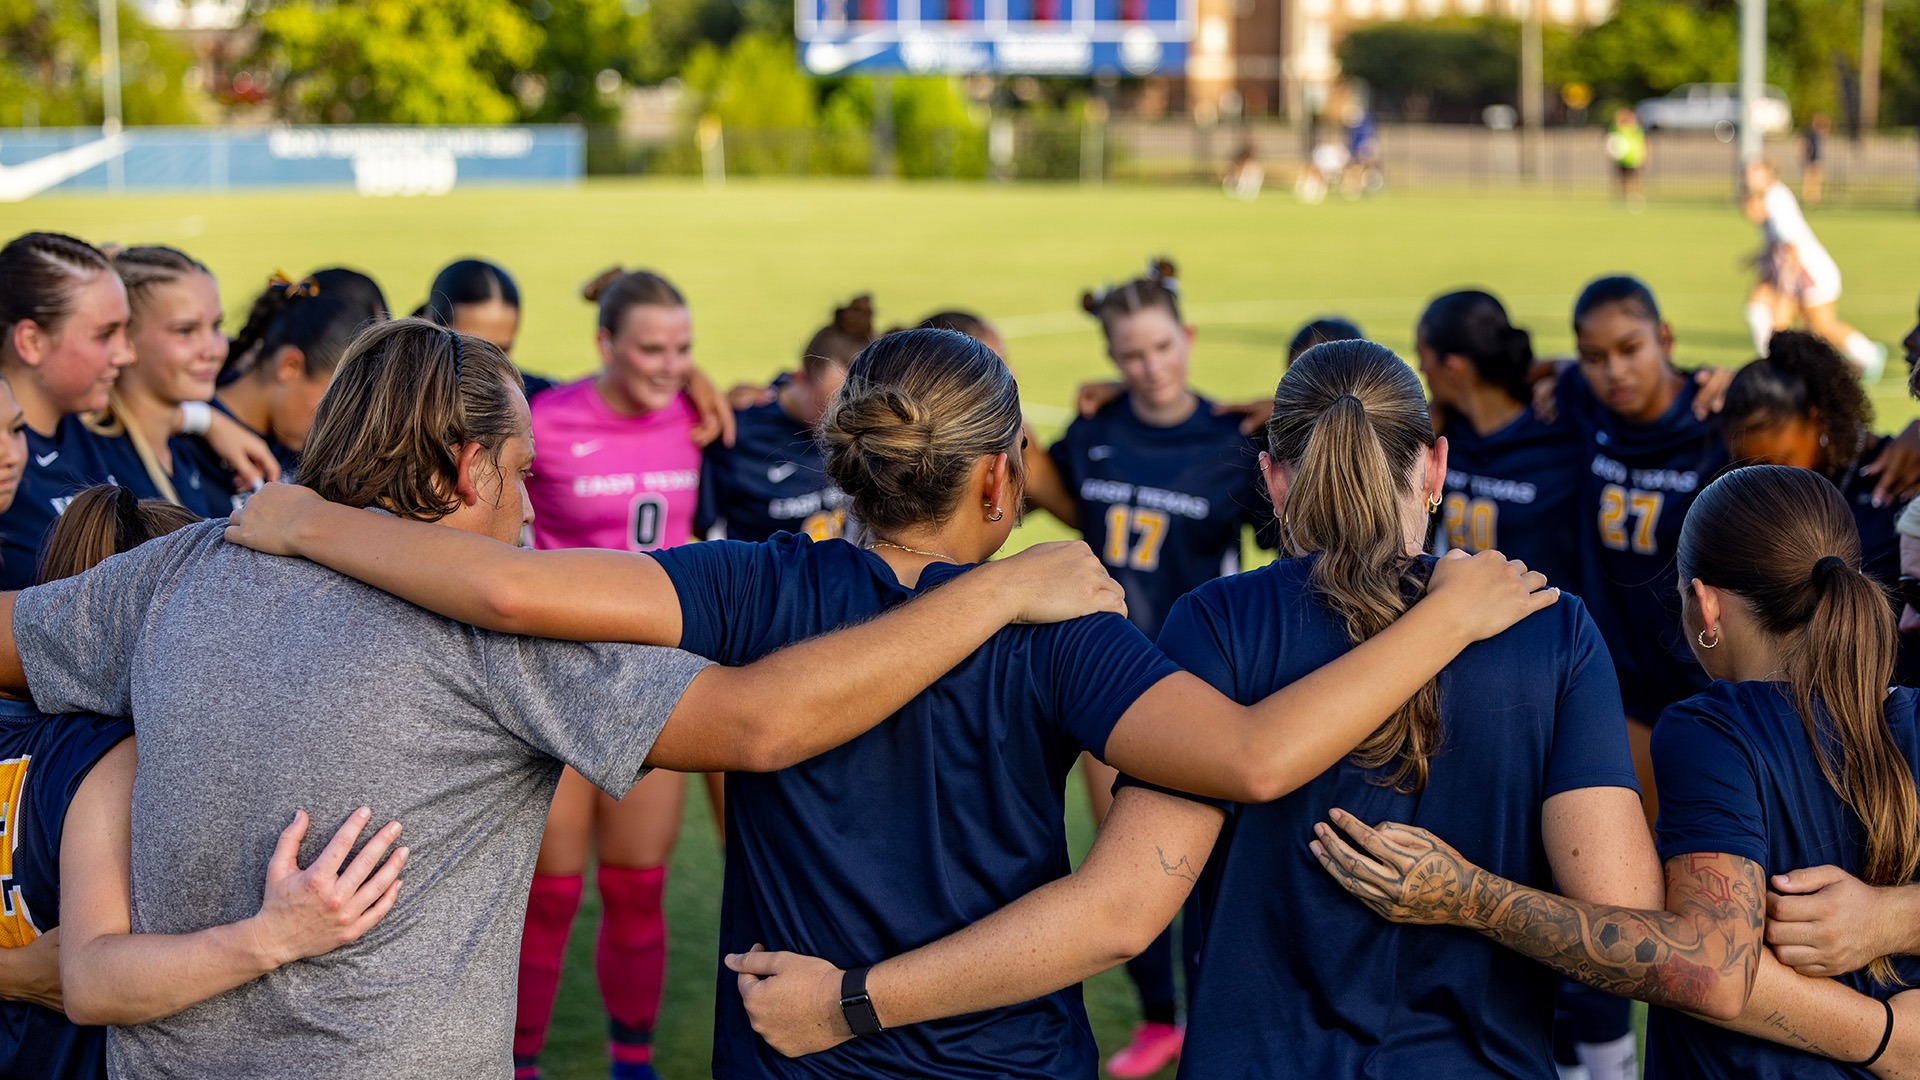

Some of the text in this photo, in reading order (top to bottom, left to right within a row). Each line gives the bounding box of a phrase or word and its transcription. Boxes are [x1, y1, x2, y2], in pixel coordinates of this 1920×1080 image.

[627, 491, 668, 551] 0
[1103, 503, 1170, 572] 17
[1442, 491, 1499, 552] 20
[1598, 483, 1663, 554] 27
